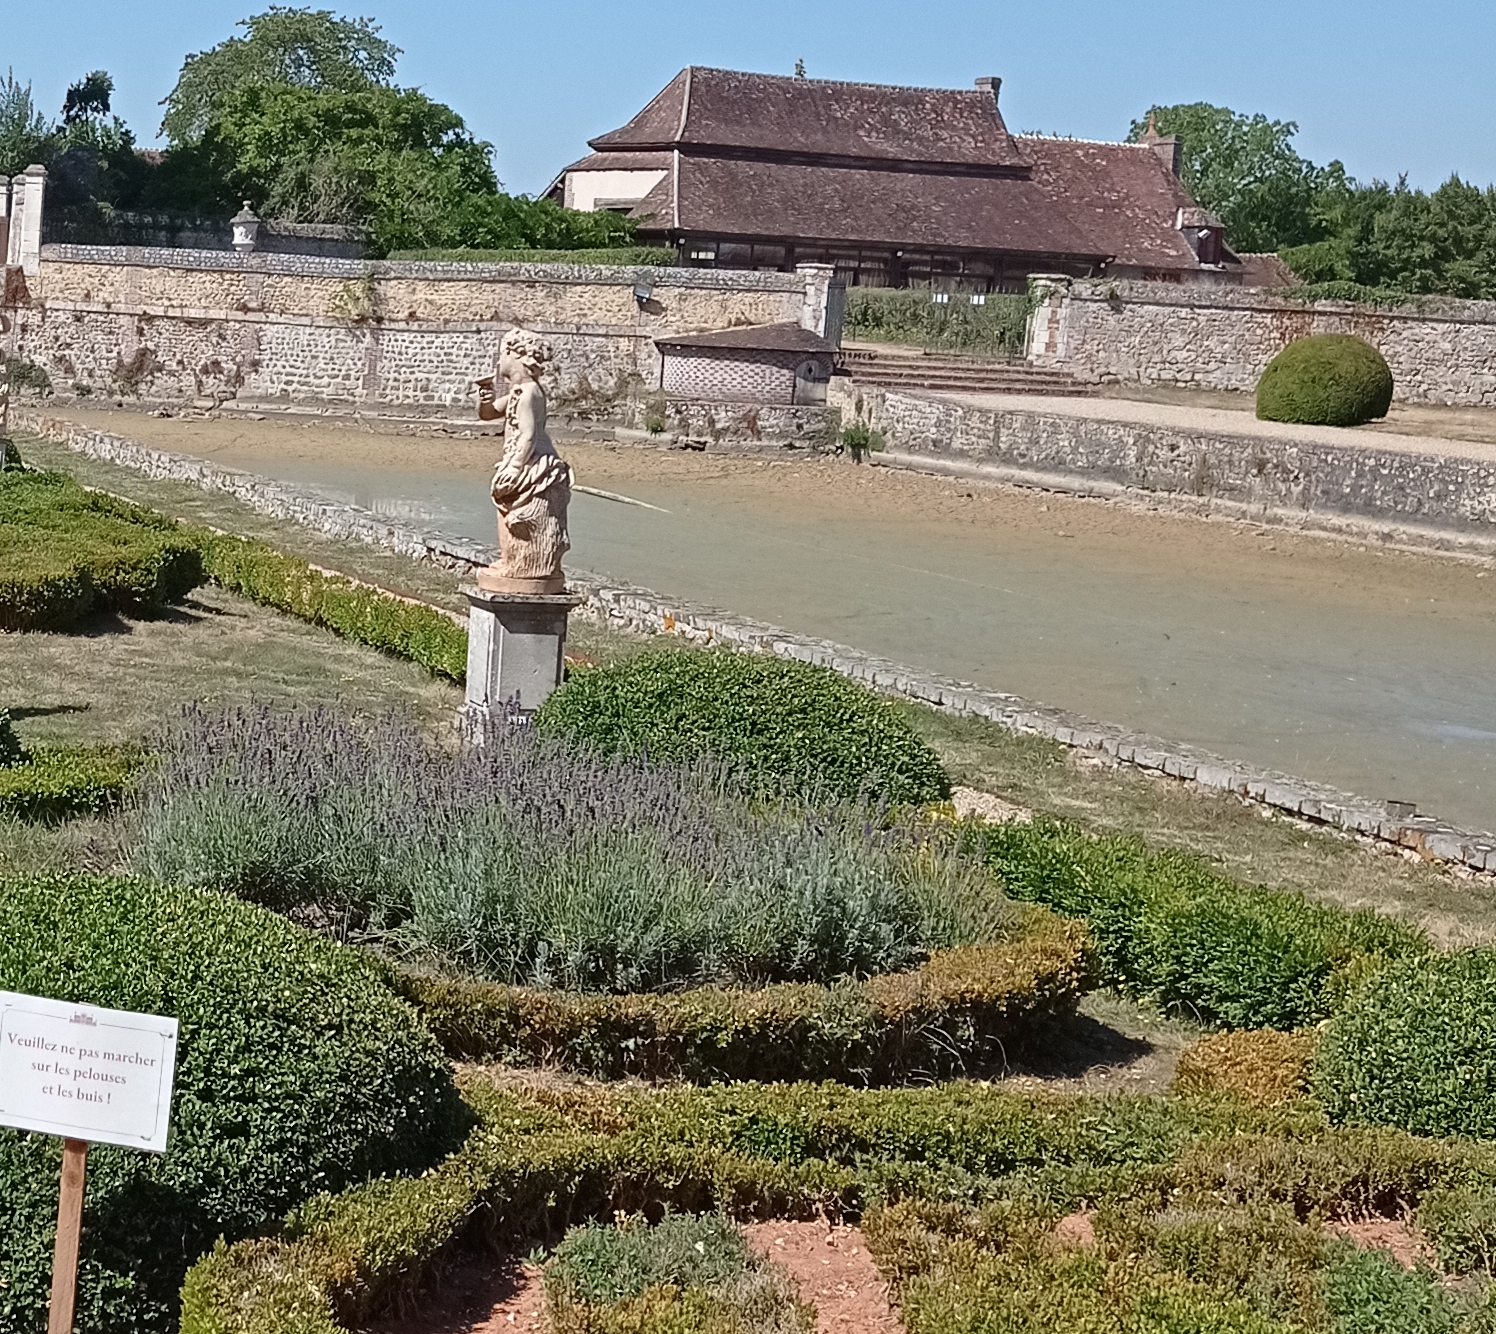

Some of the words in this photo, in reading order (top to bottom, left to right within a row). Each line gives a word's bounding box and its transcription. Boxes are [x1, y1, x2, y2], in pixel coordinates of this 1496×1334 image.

[7, 1032, 57, 1052] Veuillez
[61, 1043, 76, 1055] ne
[79, 1047, 99, 1060] pas
[103, 1050, 157, 1067] marcher
[31, 1061, 51, 1072] sur
[54, 1063, 70, 1076] les
[73, 1068, 127, 1084] pelouses
[42, 1085, 53, 1095] et
[57, 1084, 73, 1098] les
[76, 1088, 103, 1103] buis
[107, 1093, 111, 1104] !
